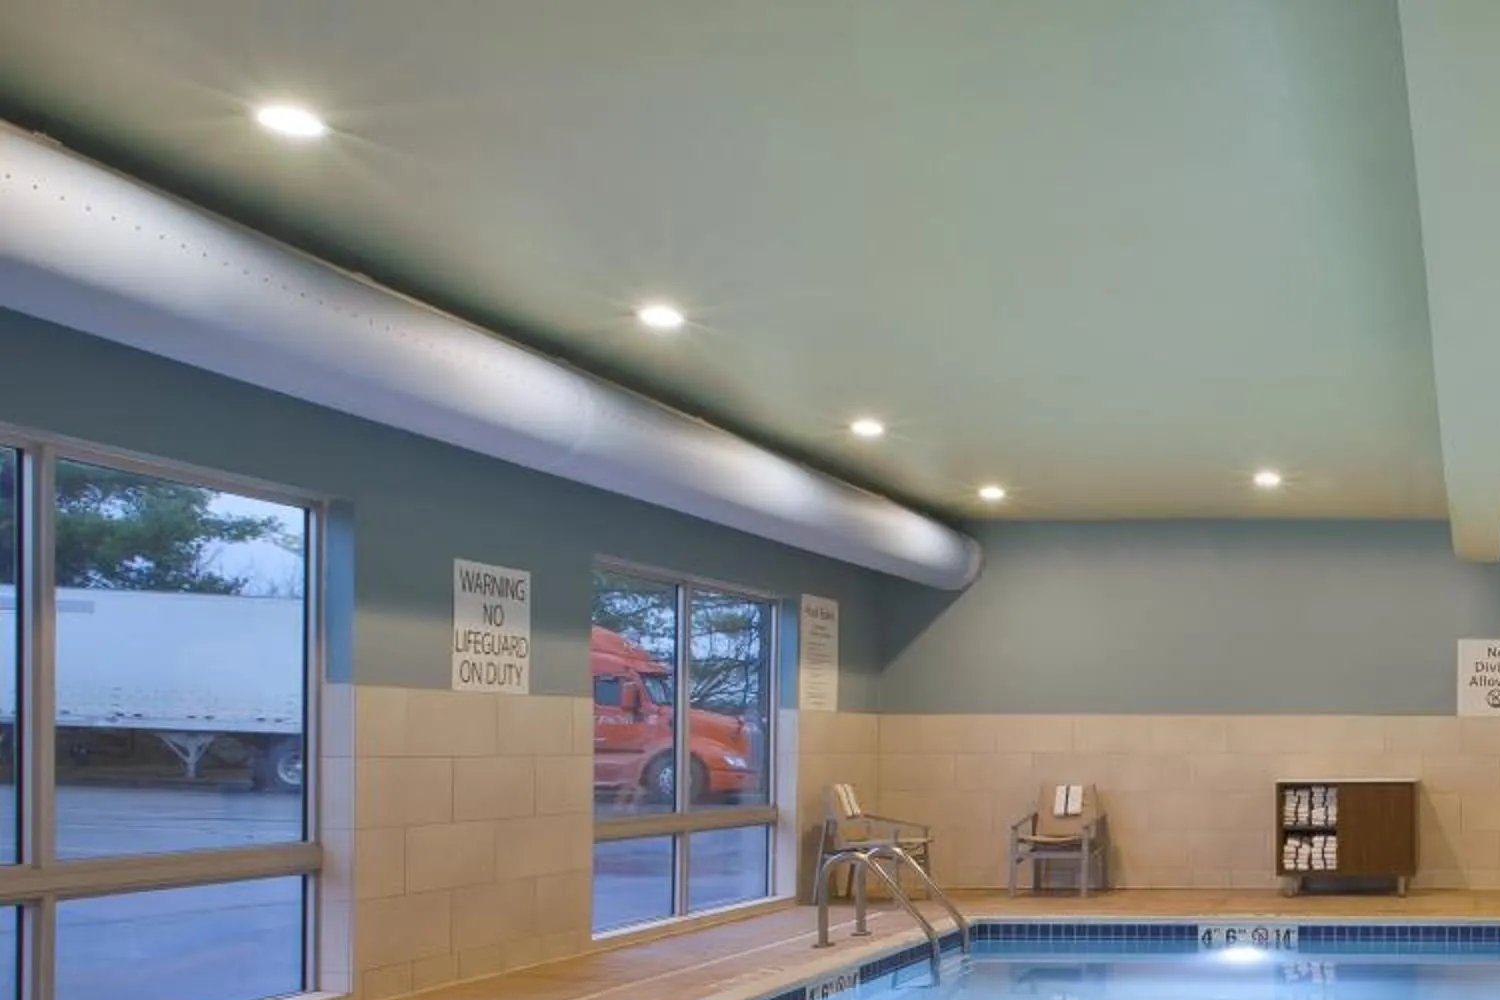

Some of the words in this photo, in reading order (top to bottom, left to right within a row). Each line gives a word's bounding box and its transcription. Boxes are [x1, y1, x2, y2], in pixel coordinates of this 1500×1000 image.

[460, 567, 525, 602] WARNING
[482, 602, 505, 627] NO
[455, 629, 529, 659] LIFEGUARD
[459, 660, 483, 685] ON
[485, 661, 522, 686] DUTY
